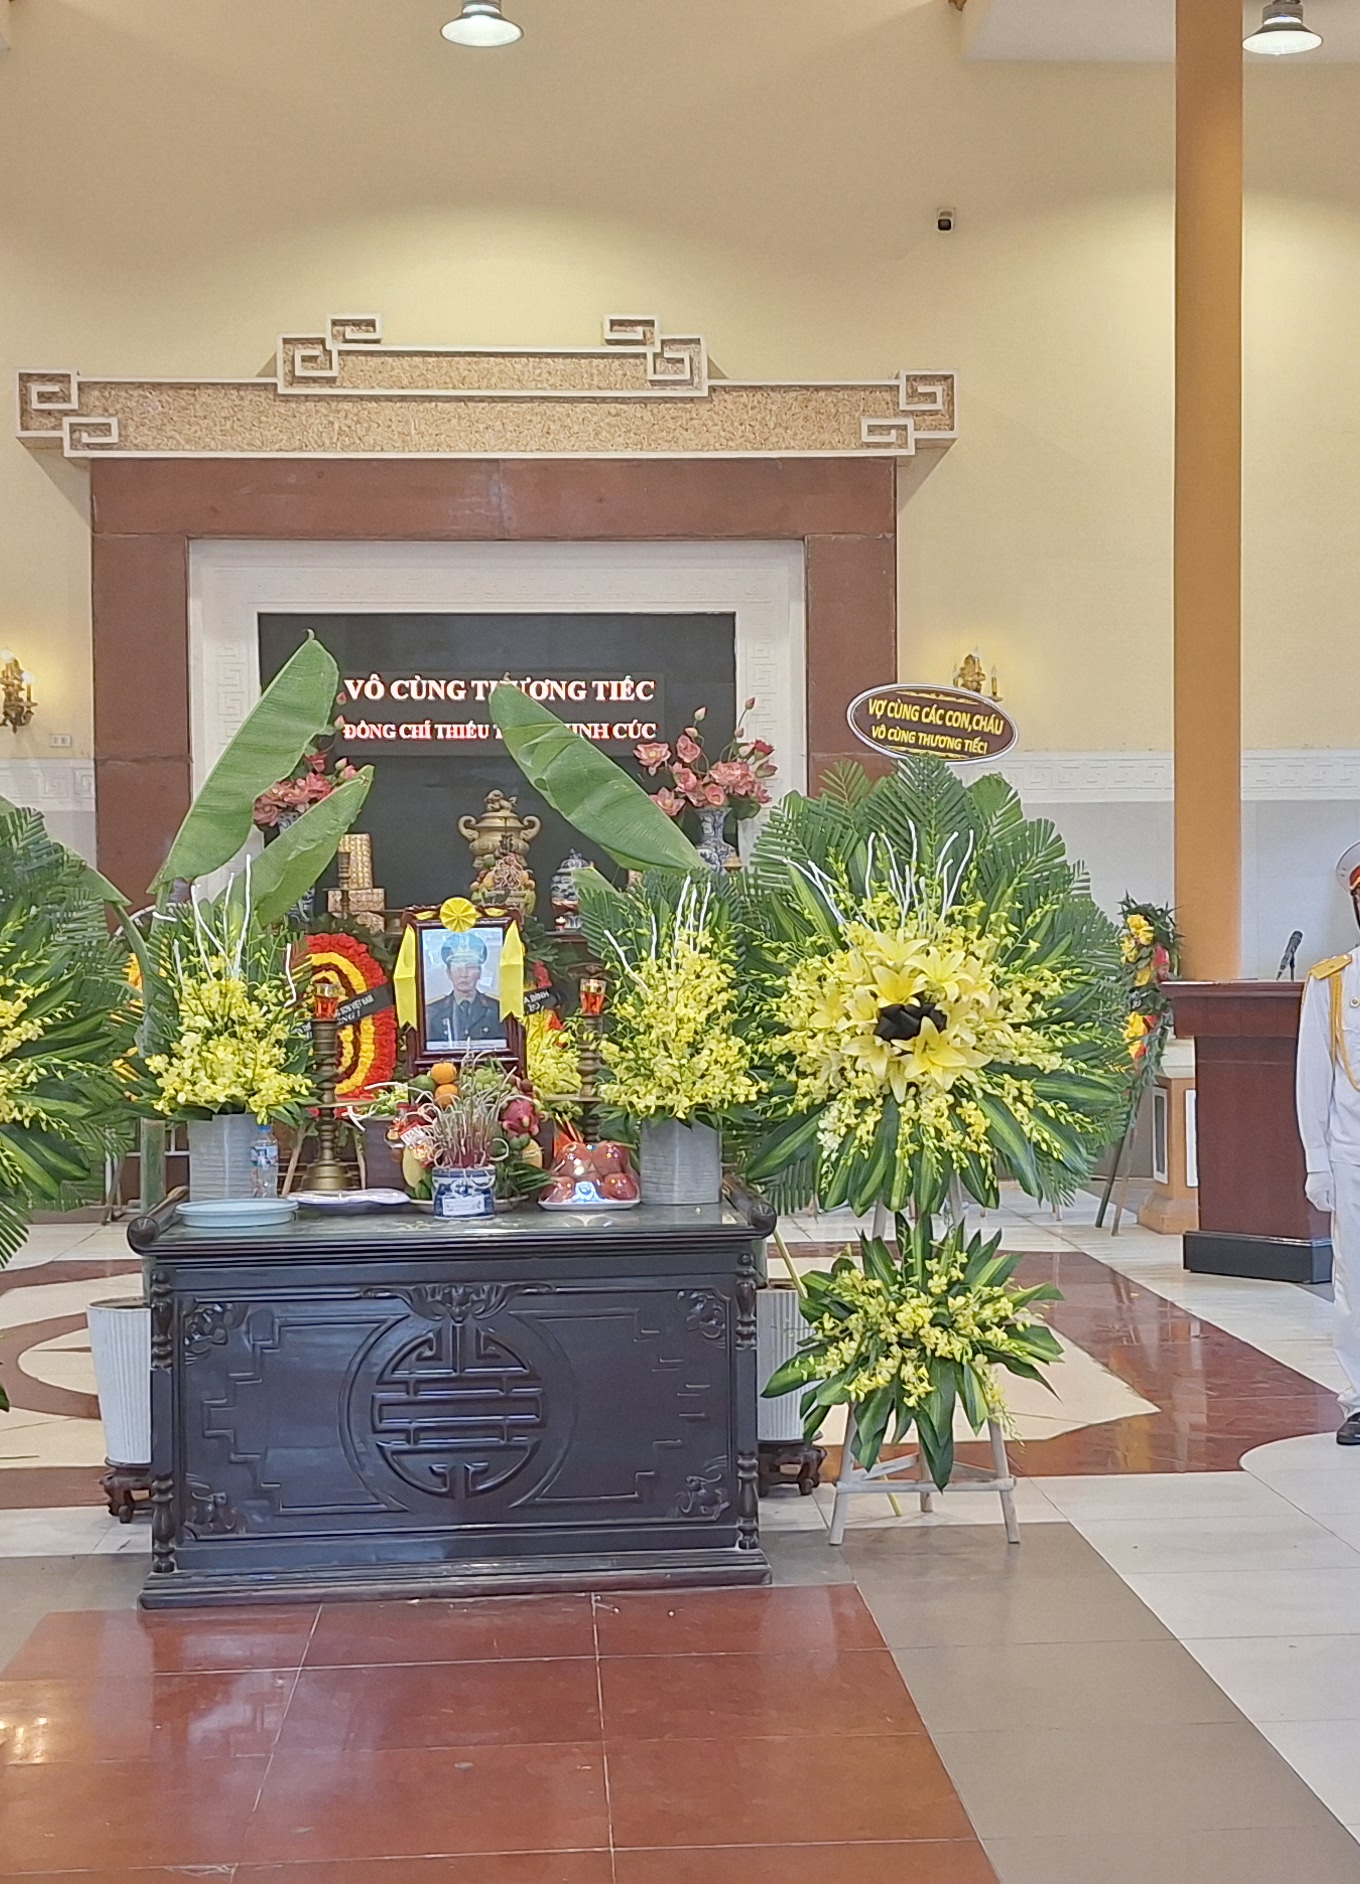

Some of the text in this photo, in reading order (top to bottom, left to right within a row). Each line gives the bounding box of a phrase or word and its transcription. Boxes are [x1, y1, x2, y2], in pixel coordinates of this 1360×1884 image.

[344, 672, 386, 701] VÔ
[390, 673, 468, 701] CÙNG
[592, 674, 656, 701] TIẾC
[868, 698, 887, 720] VỢ
[886, 698, 920, 723] CÙNG
[921, 704, 944, 726] CÁC
[343, 719, 397, 739] ĐỒNG
[398, 720, 433, 739] CHÍ
[434, 720, 490, 739] THIẾU
[564, 723, 610, 739] INH
[612, 719, 657, 739] CÚC
[871, 724, 887, 739] VÔ
[887, 726, 916, 744] CÙNG
[917, 732, 962, 750] THƯƠNG
